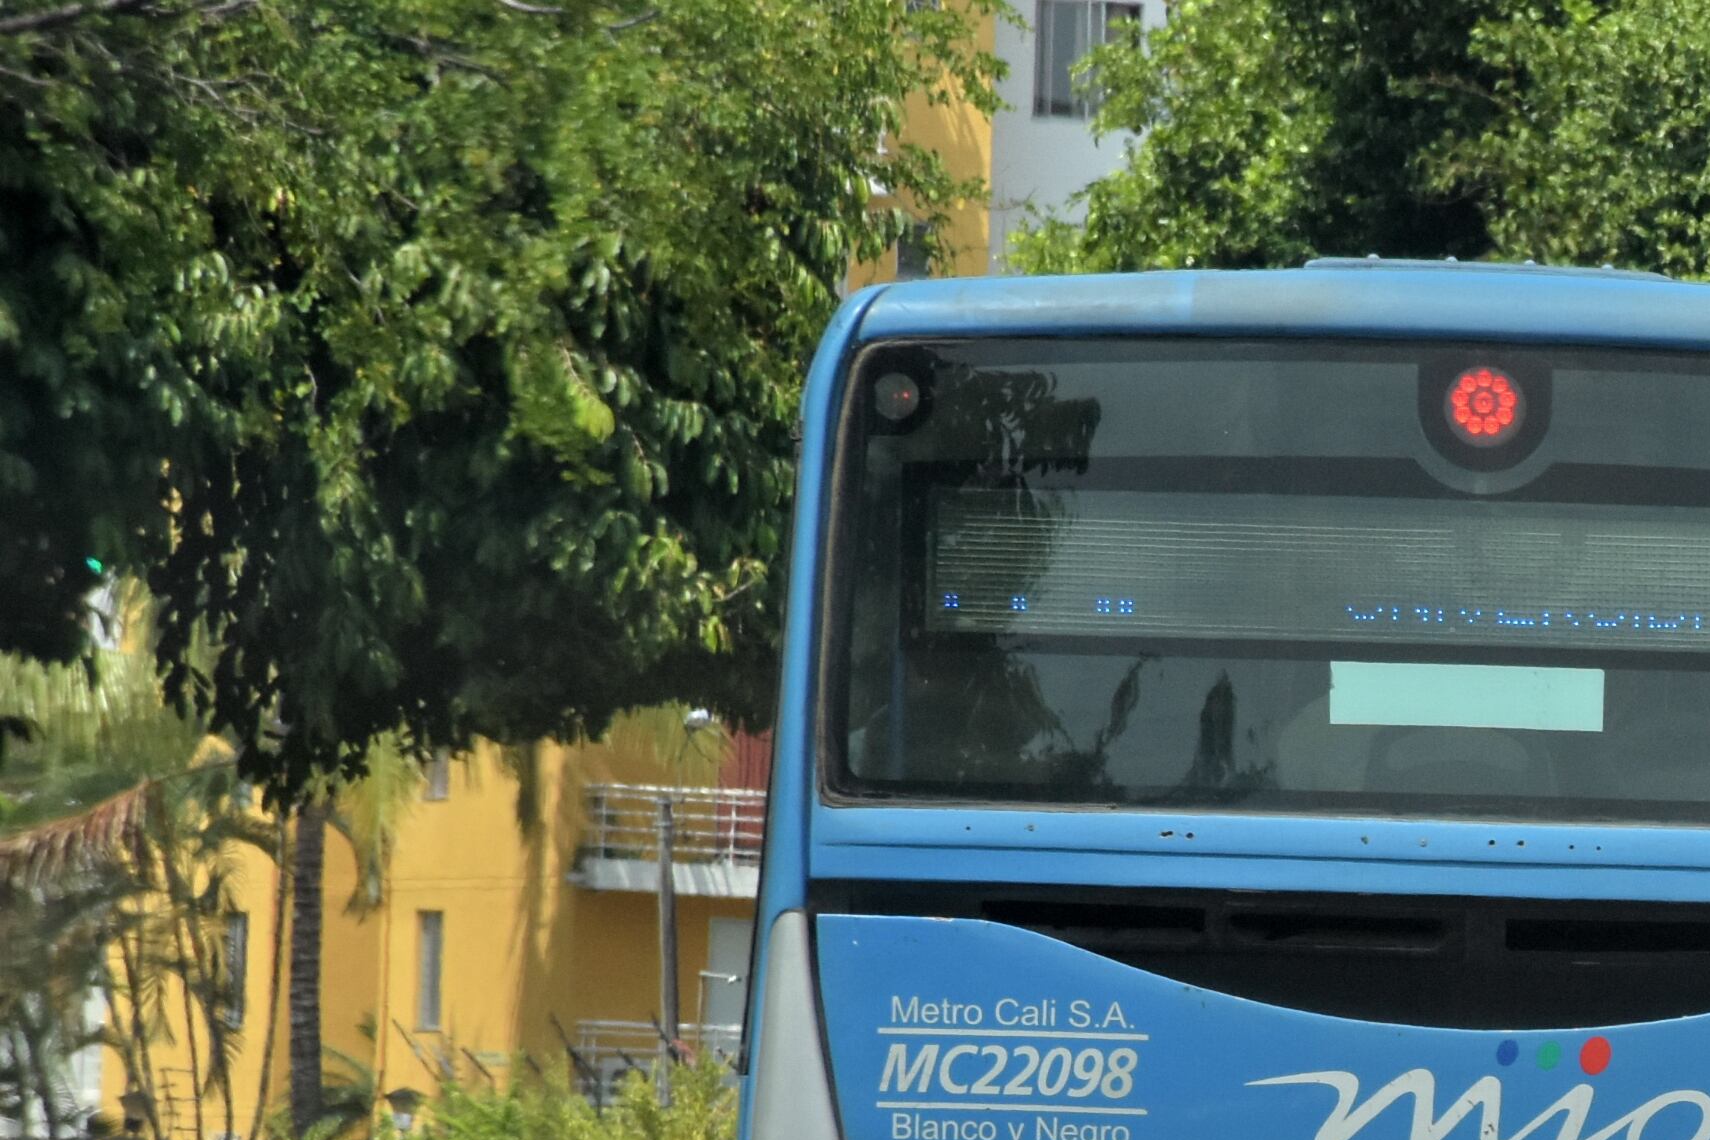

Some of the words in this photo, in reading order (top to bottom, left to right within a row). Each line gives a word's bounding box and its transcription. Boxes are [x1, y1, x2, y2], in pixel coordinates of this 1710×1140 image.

[891, 996, 983, 1025] Metro
[995, 998, 1056, 1027] Cali
[1068, 1000, 1136, 1029] S.A.
[879, 1043, 1139, 1099] MC22098
